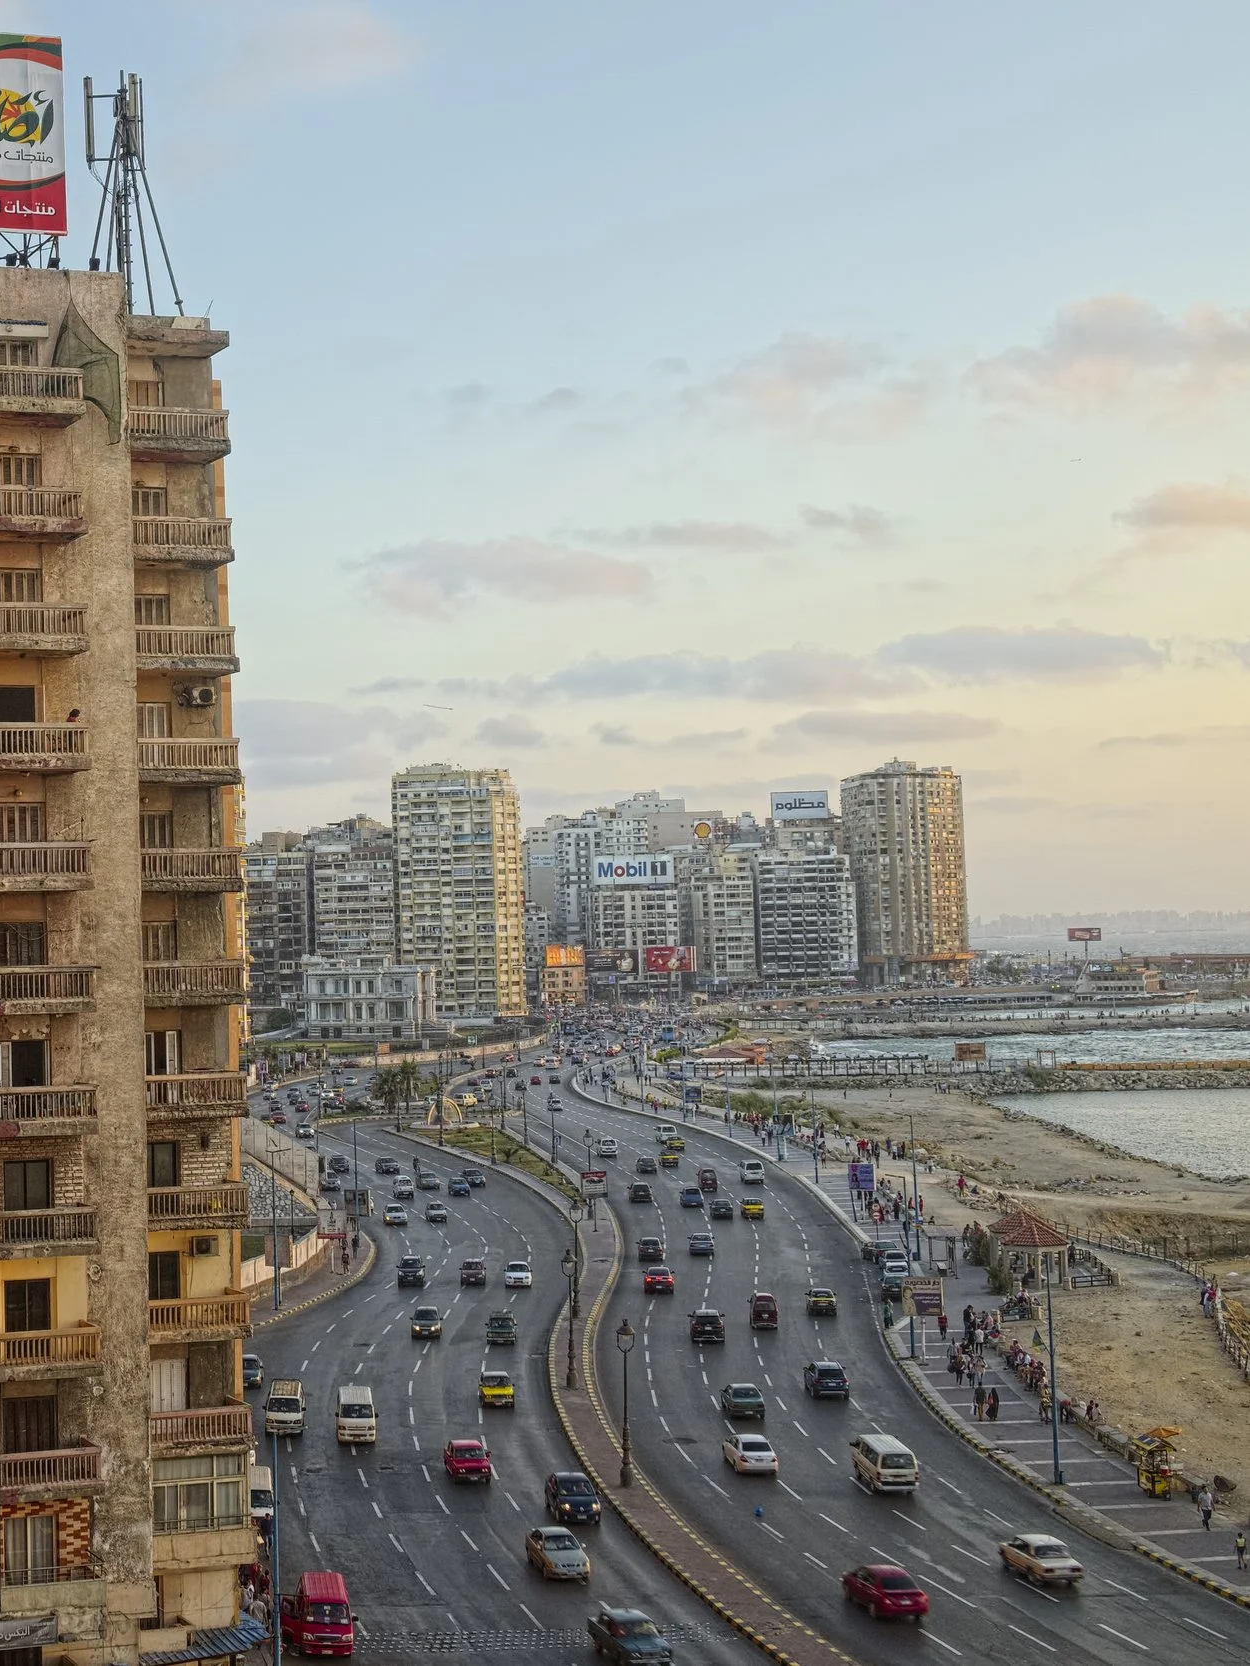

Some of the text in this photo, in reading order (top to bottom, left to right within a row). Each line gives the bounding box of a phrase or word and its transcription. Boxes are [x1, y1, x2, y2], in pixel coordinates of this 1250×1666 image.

[4, 150, 54, 165] منتجات
[4, 199, 56, 216] منتجات
[775, 798, 826, 811] مظلوم
[598, 861, 647, 878] Mobil
[5, 1625, 30, 1641] اليكس
